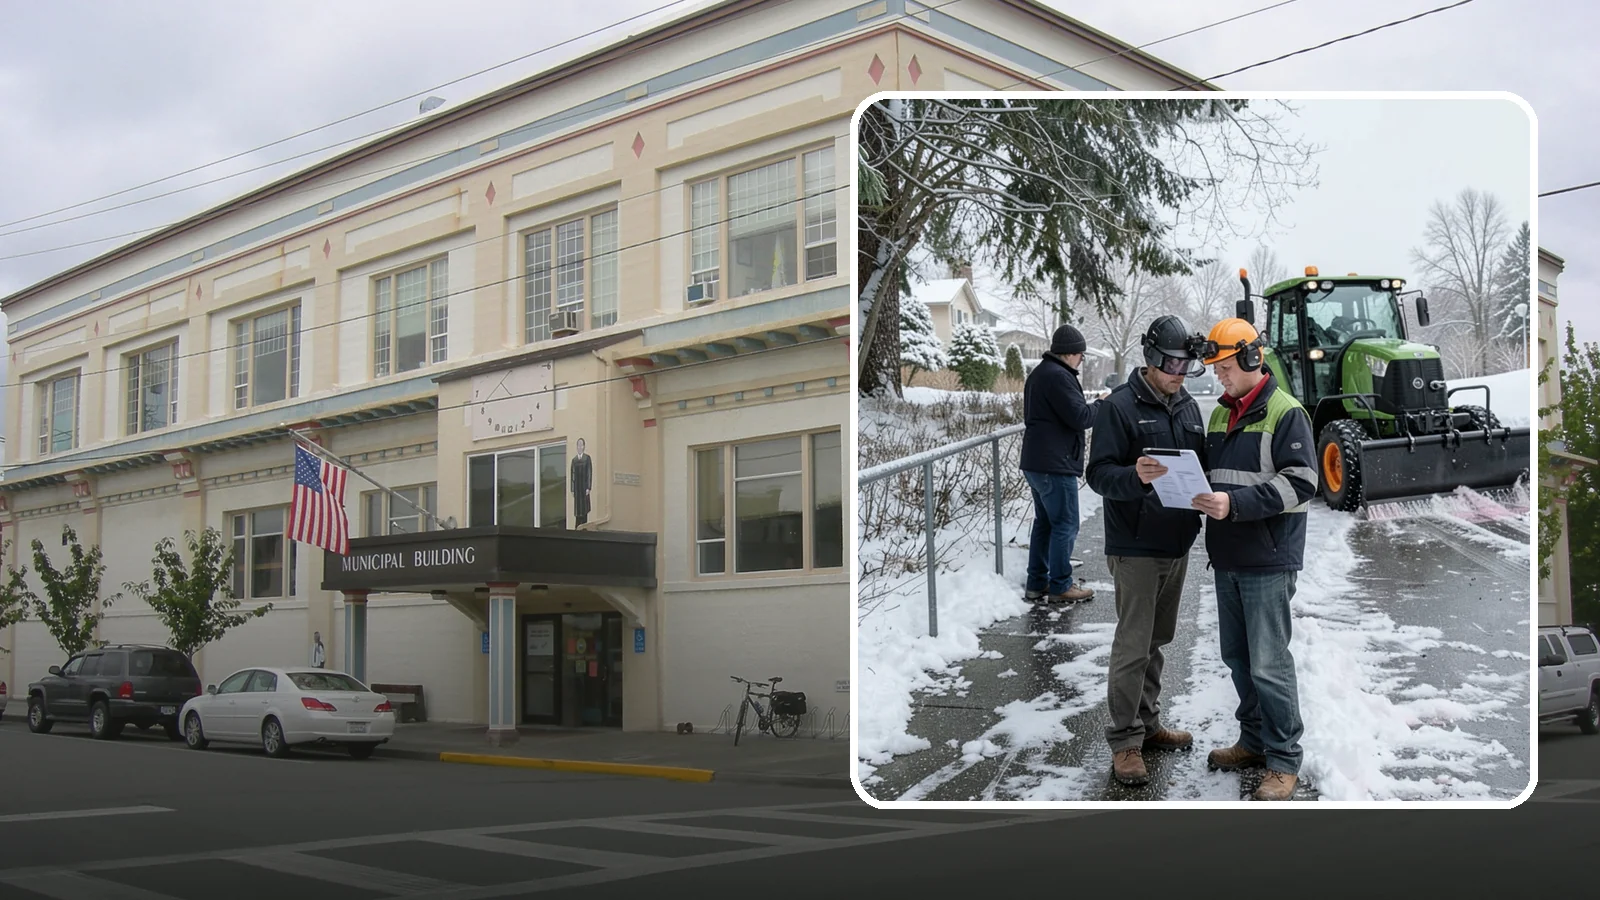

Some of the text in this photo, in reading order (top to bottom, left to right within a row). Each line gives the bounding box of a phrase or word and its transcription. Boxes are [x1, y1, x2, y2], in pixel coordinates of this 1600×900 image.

[536, 402, 540, 410] 4
[529, 414, 533, 422] 3
[521, 420, 526, 428] 2
[507, 425, 513, 433] 12
[342, 546, 475, 572] MUNICIPAL BUILDING
